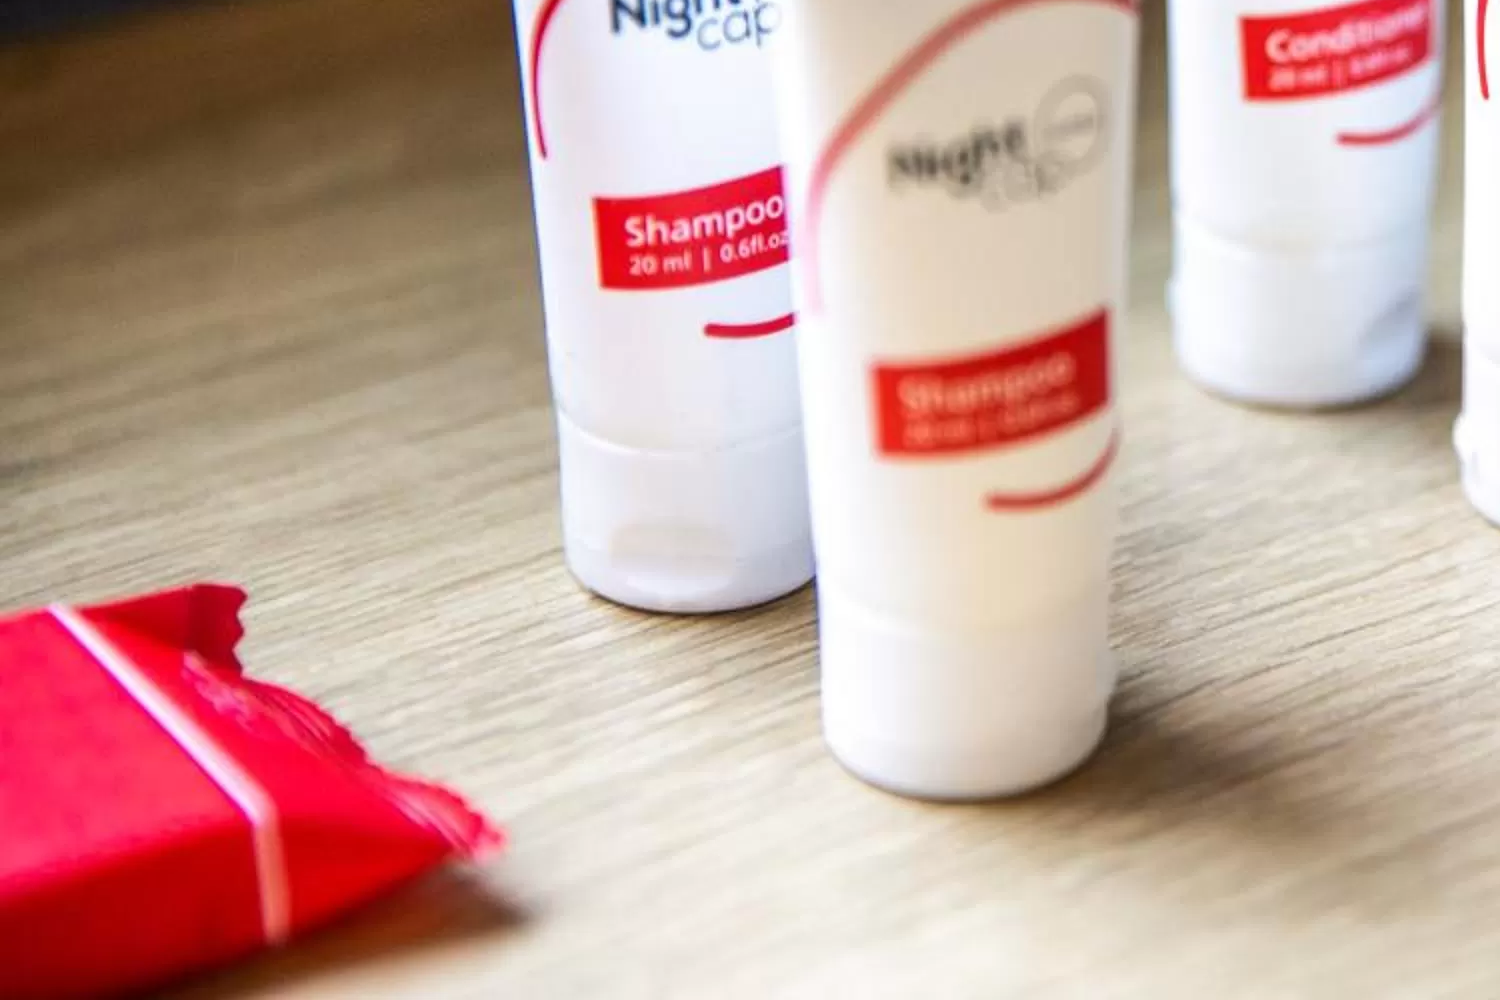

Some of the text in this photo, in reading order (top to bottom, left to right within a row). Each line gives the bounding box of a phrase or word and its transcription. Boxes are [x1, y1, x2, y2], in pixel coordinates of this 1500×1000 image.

[696, 1, 783, 50] cap
[624, 194, 784, 248] Shampoo
[628, 254, 658, 277] 20
[662, 250, 692, 274] ml
